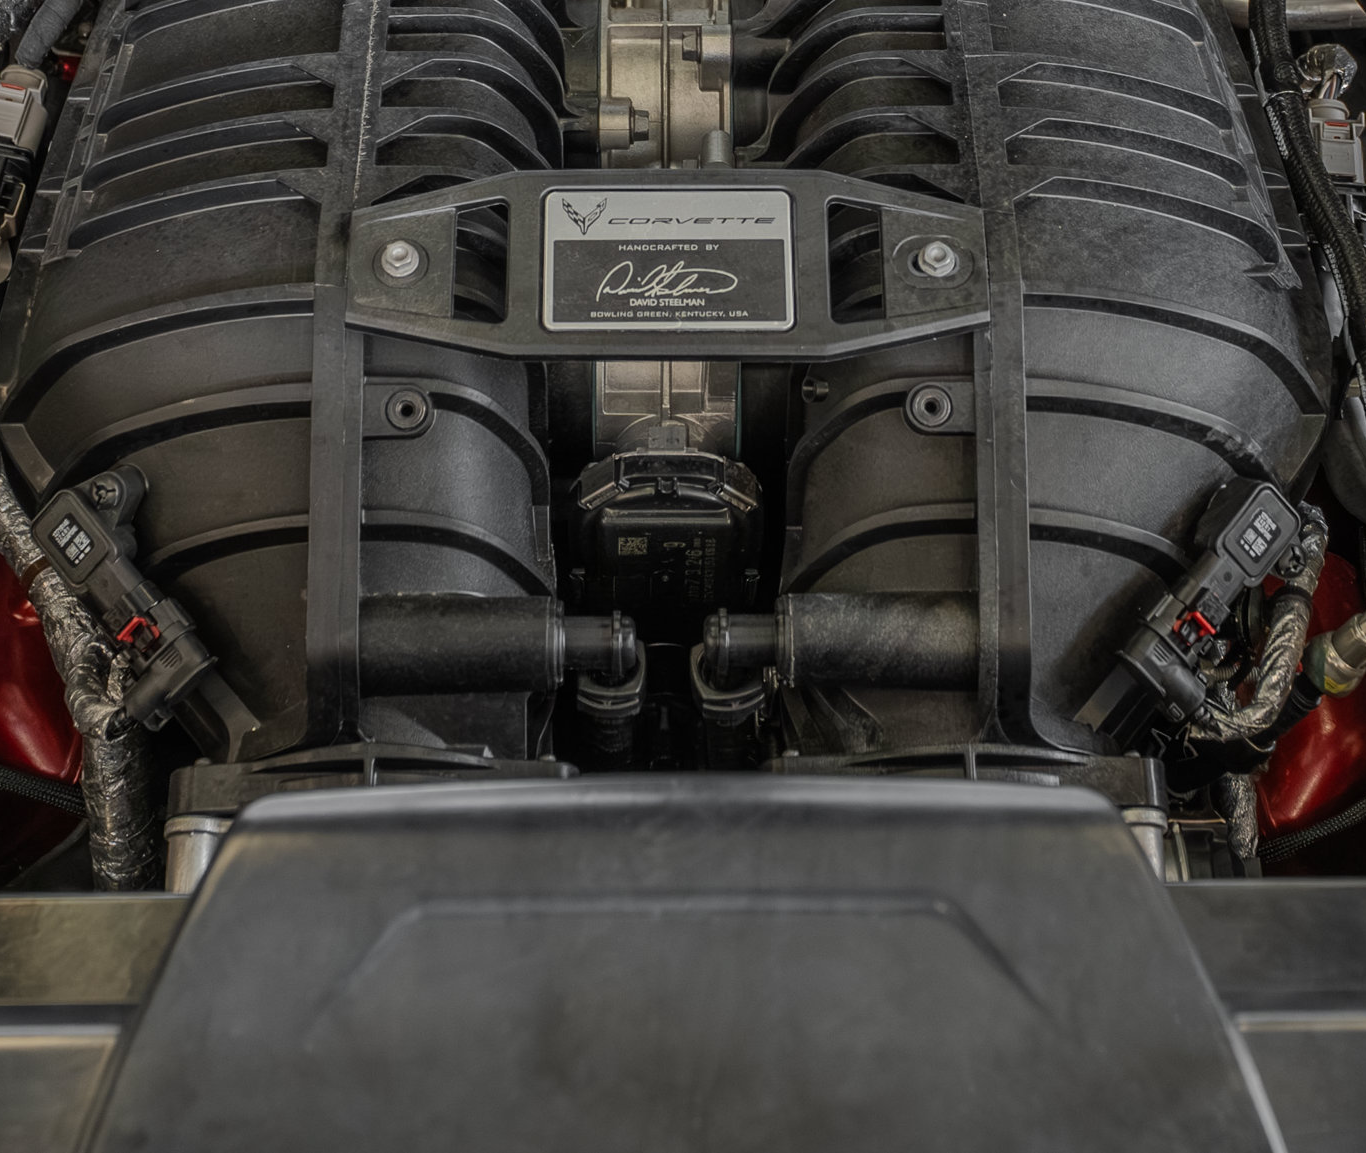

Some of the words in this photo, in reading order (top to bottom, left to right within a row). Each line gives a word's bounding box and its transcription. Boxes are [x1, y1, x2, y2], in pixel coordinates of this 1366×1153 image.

[608, 217, 776, 225] CORVETTE
[629, 298, 657, 307] DAVID
[659, 298, 705, 307] STEELMAN
